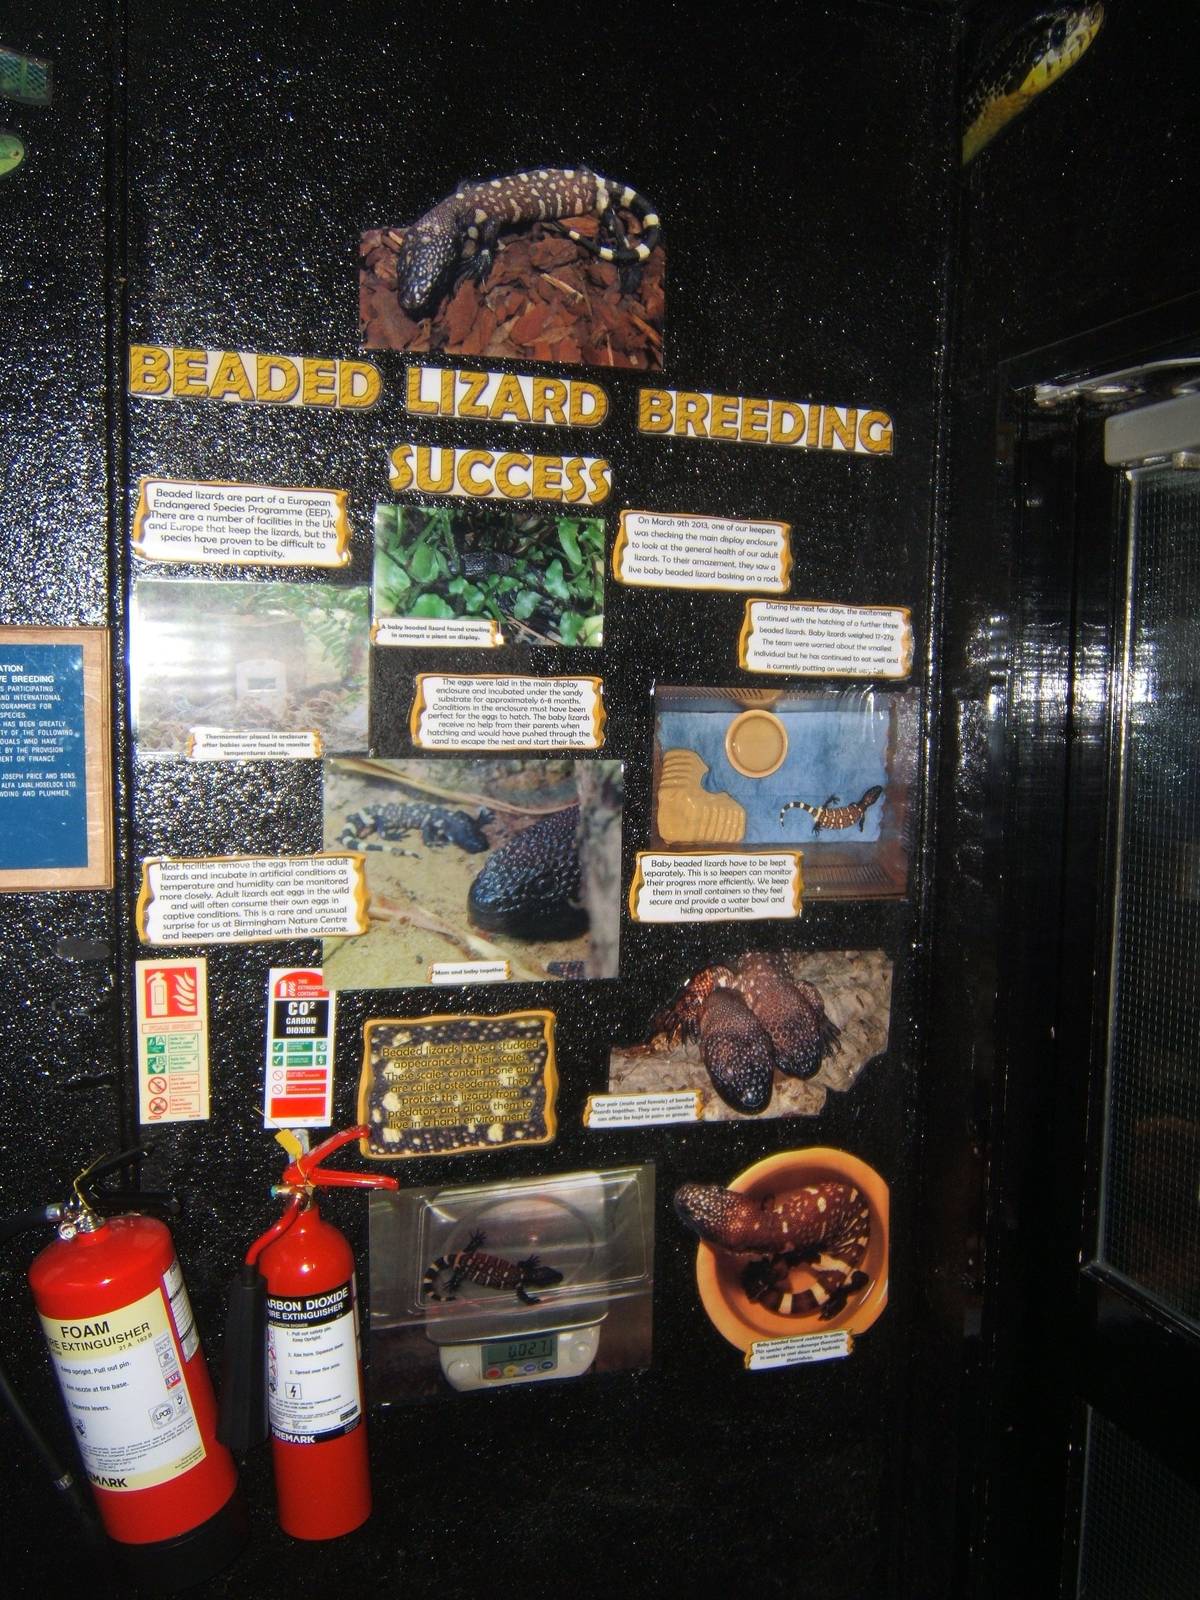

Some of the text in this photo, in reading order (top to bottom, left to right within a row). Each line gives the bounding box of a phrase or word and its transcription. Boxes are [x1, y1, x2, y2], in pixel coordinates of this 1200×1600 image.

[130, 345, 892, 455] BEADED LIZARD BREEDING
[389, 443, 610, 504] SUCCESS
[156, 488, 193, 499] Beaded
[195, 490, 224, 501] lizards
[244, 494, 264, 504] part
[267, 495, 276, 503] of
[287, 495, 331, 508] European
[154, 498, 333, 519] Endangered Species Programme (EEP).
[638, 517, 650, 525] On
[651, 518, 675, 526] March
[677, 520, 690, 528] 9th
[726, 523, 734, 531] of
[749, 525, 775, 535] keepers
[203, 545, 285, 560] breed in captivity.
[643, 566, 663, 577] baby
[665, 568, 694, 577] beaded
[695, 570, 716, 578] lizard
[717, 571, 745, 582] basking
[766, 602, 788, 612] During
[816, 605, 828, 613] few
[858, 608, 892, 616] excitement
[12, 675, 54, 683] BREEDING
[436, 686, 470, 694] enclosure
[488, 687, 525, 695] incubated
[562, 688, 583, 698] sandy
[438, 694, 472, 702] substrate
[485, 695, 538, 705] approximately
[651, 860, 672, 870] Baby
[704, 859, 727, 867] lizards
[769, 859, 786, 868] kept
[161, 872, 189, 880] lizards
[191, 871, 208, 879] and
[210, 870, 248, 878] incubate
[259, 868, 294, 877] artificial
[295, 868, 336, 876] conditions
[644, 869, 686, 879] separately.
[719, 868, 747, 878] keepers
[647, 878, 664, 886] their
[666, 880, 696, 888] progress
[719, 878, 756, 887] efficiently.
[757, 877, 770, 885] We
[771, 877, 789, 887] keep
[163, 920, 195, 931] surprise
[197, 920, 208, 928] for
[222, 919, 232, 927] at
[234, 917, 286, 928] Birmingham
[288, 916, 318, 924] Nature
[320, 915, 347, 923] Centre
[286, 1017, 317, 1025] CARBON
[286, 1026, 315, 1034] DIOXIDE
[382, 1045, 423, 1056] Beaded
[426, 1044, 457, 1054] lizards
[461, 1043, 486, 1052] have
[499, 1039, 539, 1050] studded
[394, 1058, 455, 1070] appearance
[459, 1055, 468, 1064] to
[472, 1054, 495, 1063] their
[388, 1099, 533, 1119] predators and allow them to
[306, 1287, 349, 1310] DIOXIDE
[282, 1302, 344, 1320] EXTINGUISHER
[60, 1321, 110, 1339] FOAM
[62, 1322, 150, 1351] EXTINGUISHER
